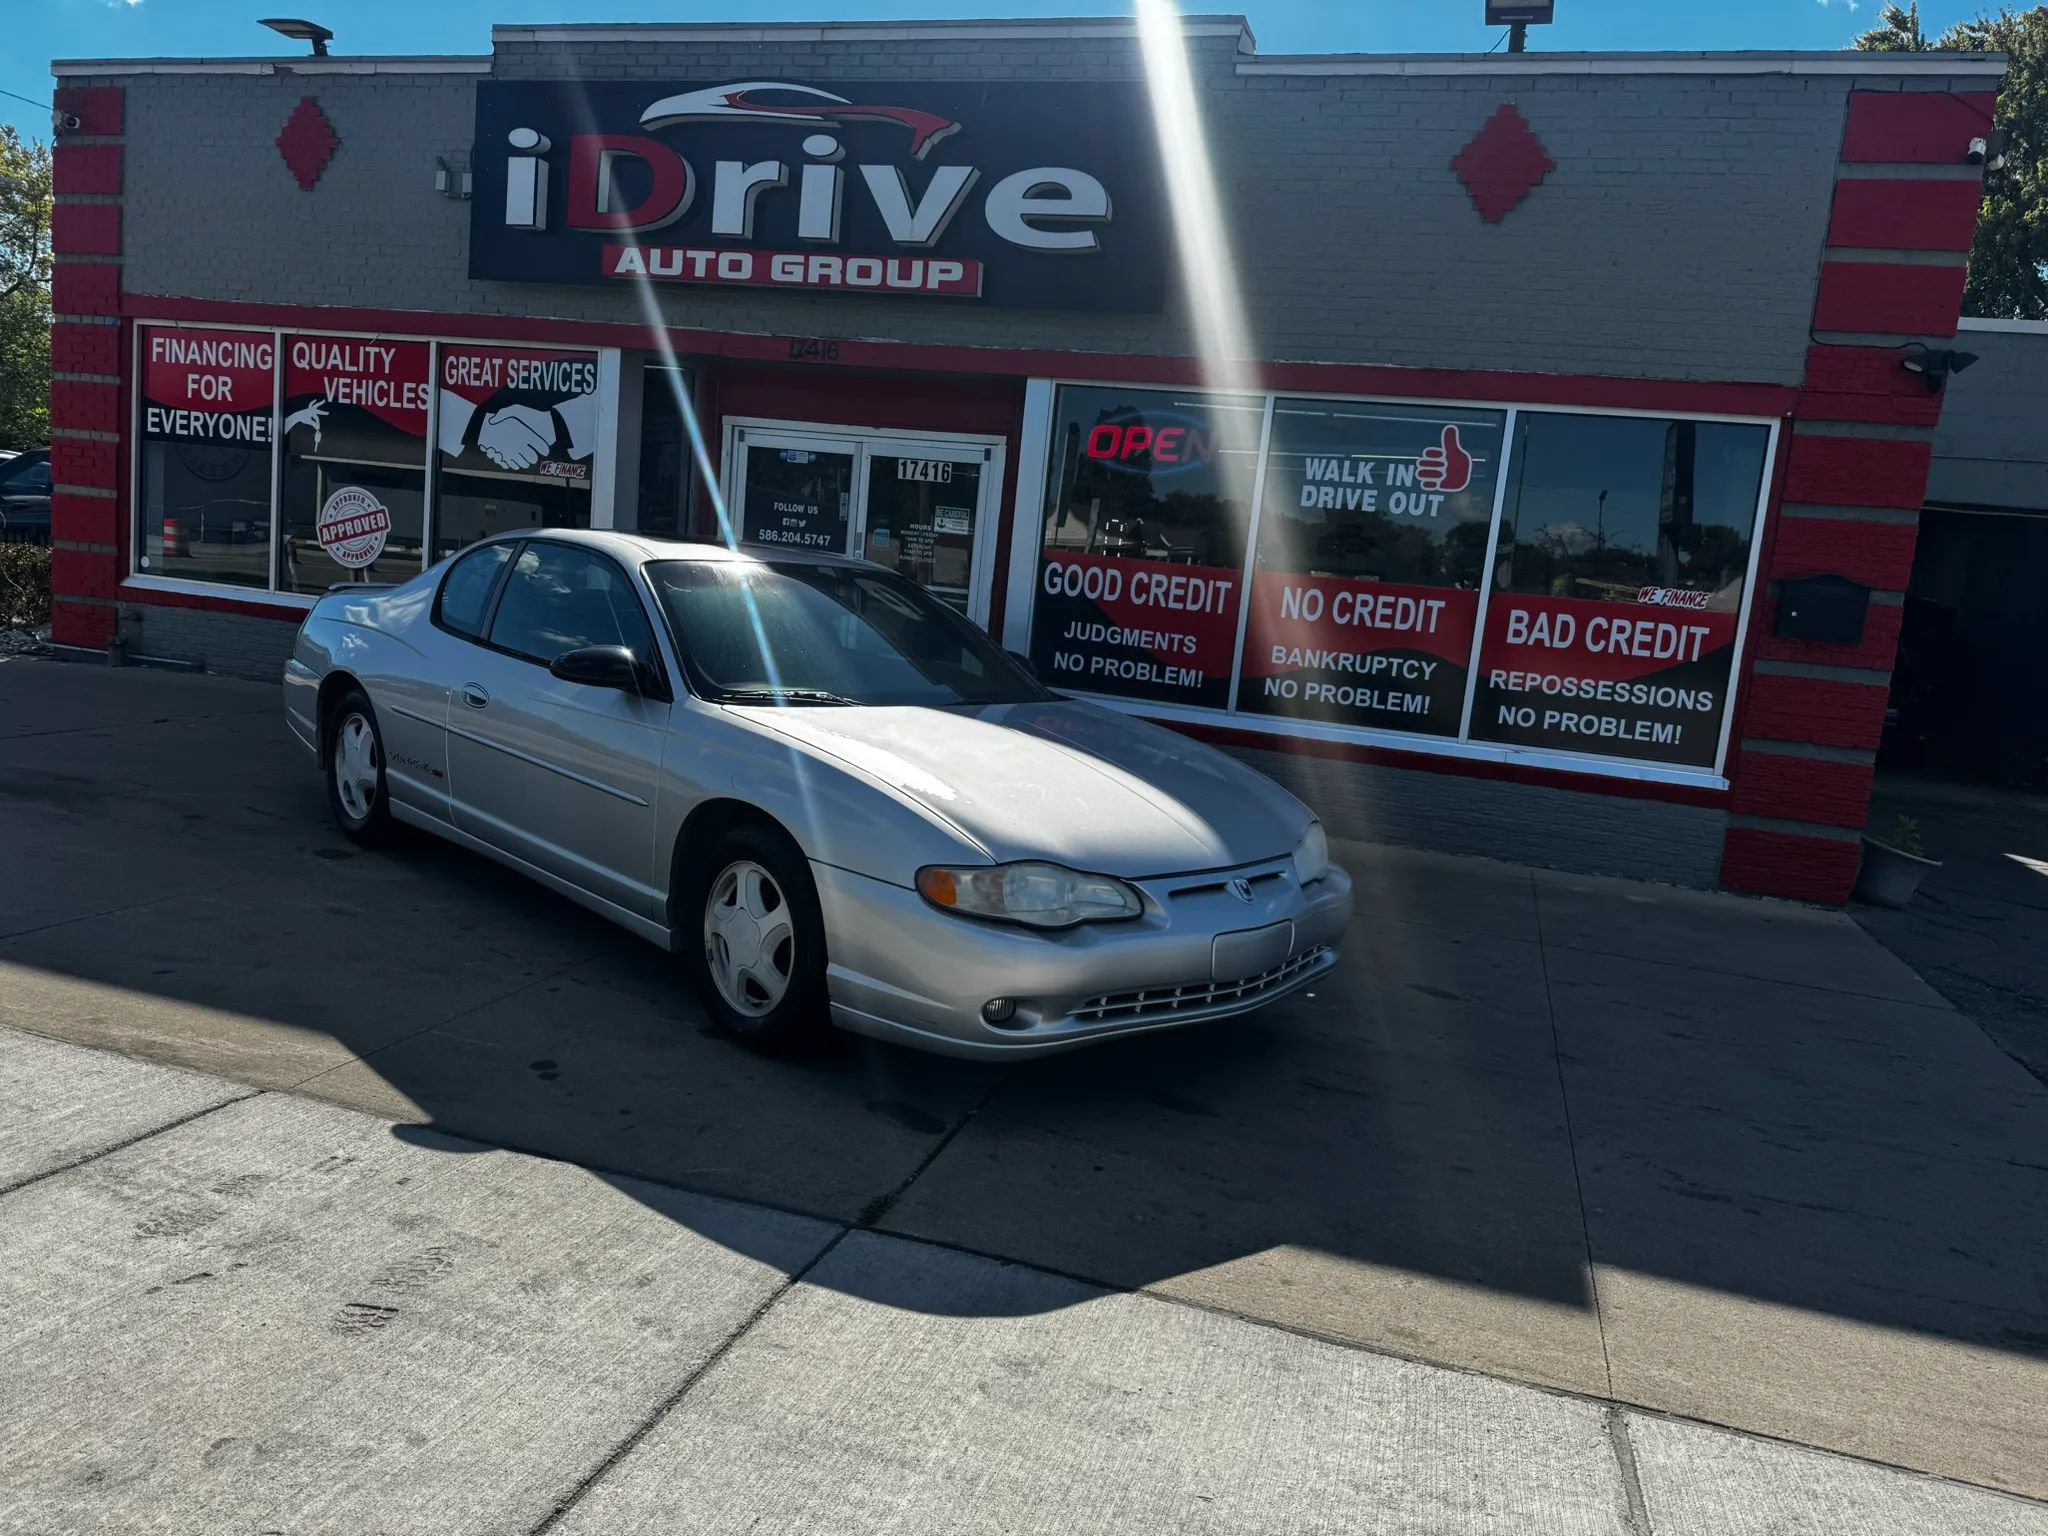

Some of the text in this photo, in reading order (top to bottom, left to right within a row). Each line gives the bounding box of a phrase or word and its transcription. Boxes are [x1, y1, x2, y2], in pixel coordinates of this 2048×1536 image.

[504, 127, 1114, 252] iDrive
[614, 247, 964, 291] AUTO GROUP
[151, 337, 273, 370] FINANCING
[293, 342, 396, 375] QUALITY
[187, 374, 233, 402] FOR
[445, 355, 595, 394] GREAT SERVICES
[323, 376, 429, 411] VEHICLES
[147, 408, 273, 443] EVERYONE!
[1086, 424, 1217, 463] OPEN
[540, 461, 587, 478] WE FINANCE
[900, 460, 950, 482] 17416
[1304, 456, 1414, 489] WALK IN
[774, 502, 819, 515] FOLLOW US
[1301, 487, 1444, 518] DRIVE OUT
[322, 512, 386, 542] APPROVED
[758, 529, 831, 546] 586.204.5747
[909, 523, 932, 531] HOURS
[342, 544, 375, 561] APPROVED
[1044, 561, 1232, 615] GOOD CREDIT
[1638, 586, 1710, 609] WE FINANCE
[1281, 585, 1445, 634] NO CREDIT
[1064, 621, 1197, 655] JUDGMENTS
[1506, 609, 1709, 662] BAD CREDIT
[1054, 651, 1204, 688] NO PROBLEM!
[1271, 645, 1437, 681] BANKRUPTCY
[1264, 676, 1430, 715] NO PROBLEM!
[1489, 670, 1713, 712] REPOSSESSIONS
[1498, 705, 1681, 745] NO PROBLEM!
